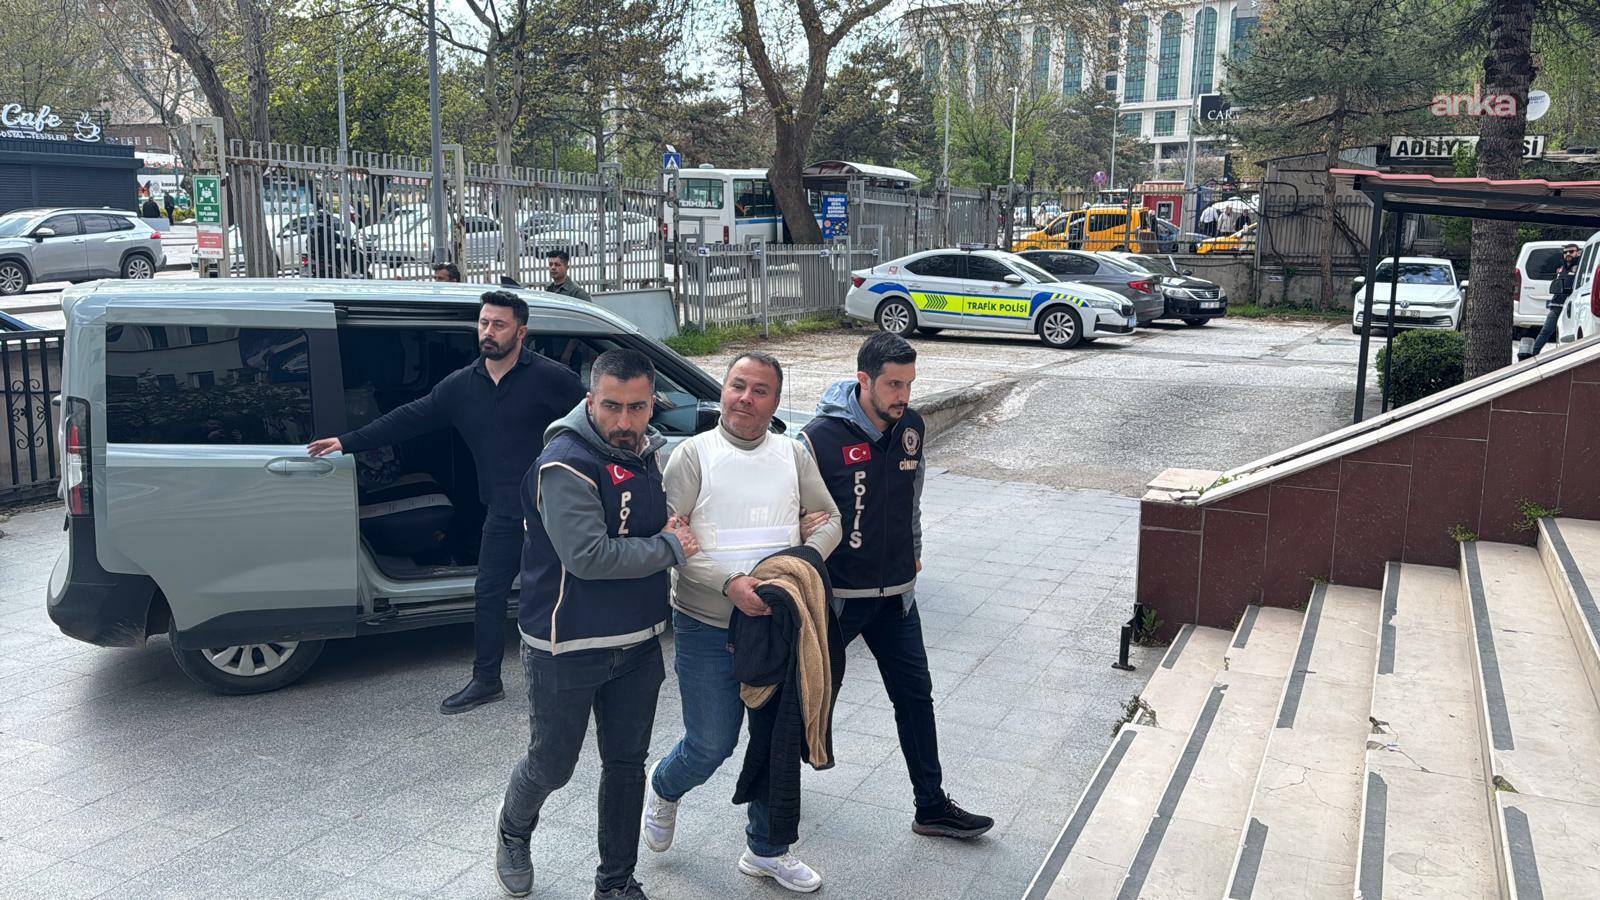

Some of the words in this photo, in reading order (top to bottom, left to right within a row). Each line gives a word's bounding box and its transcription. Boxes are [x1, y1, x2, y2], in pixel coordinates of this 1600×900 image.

[2, 104, 63, 131] Cafe
[0, 130, 25, 139] OSYAL
[967, 301, 997, 311] TRAFİK
[999, 303, 1028, 313] POLİSİ
[618, 491, 632, 538] POL
[849, 470, 866, 549] POLİS
